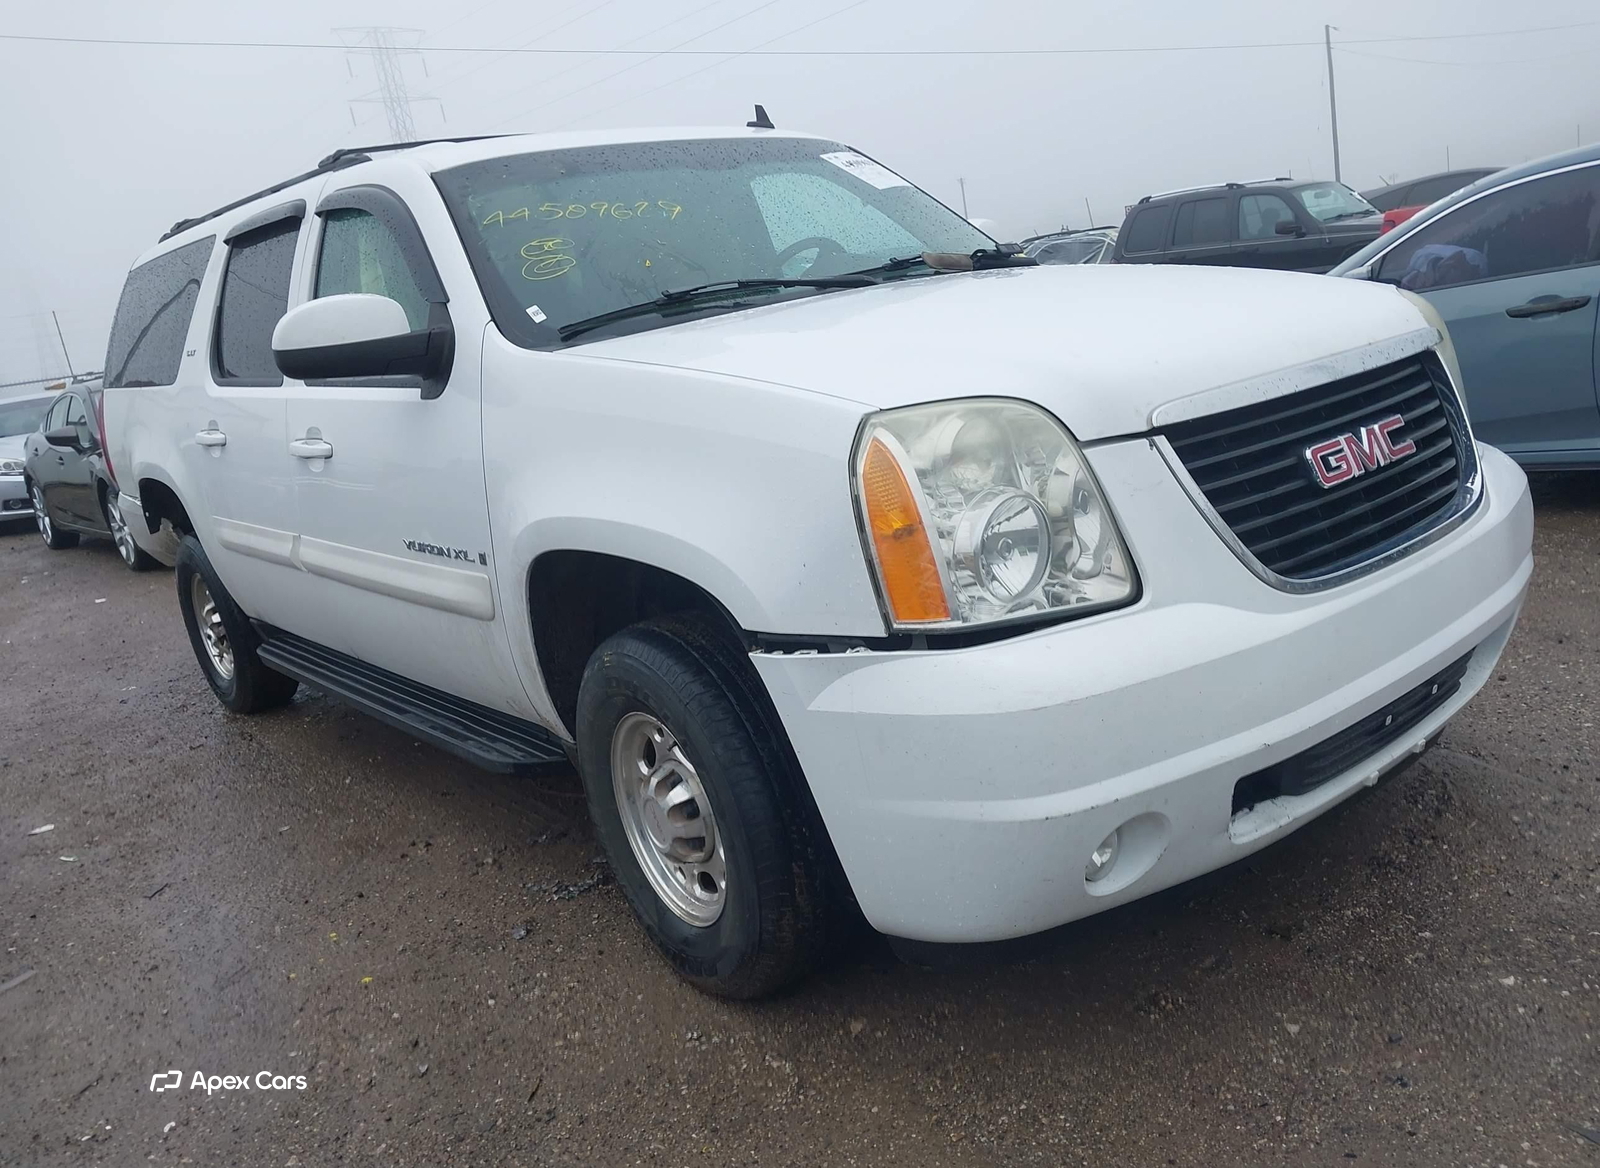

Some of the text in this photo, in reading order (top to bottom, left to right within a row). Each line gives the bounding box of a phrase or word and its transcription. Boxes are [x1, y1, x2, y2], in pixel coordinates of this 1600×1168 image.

[1303, 413, 1417, 490] GMC
[402, 538, 452, 559] YUKON
[453, 547, 476, 564] XL
